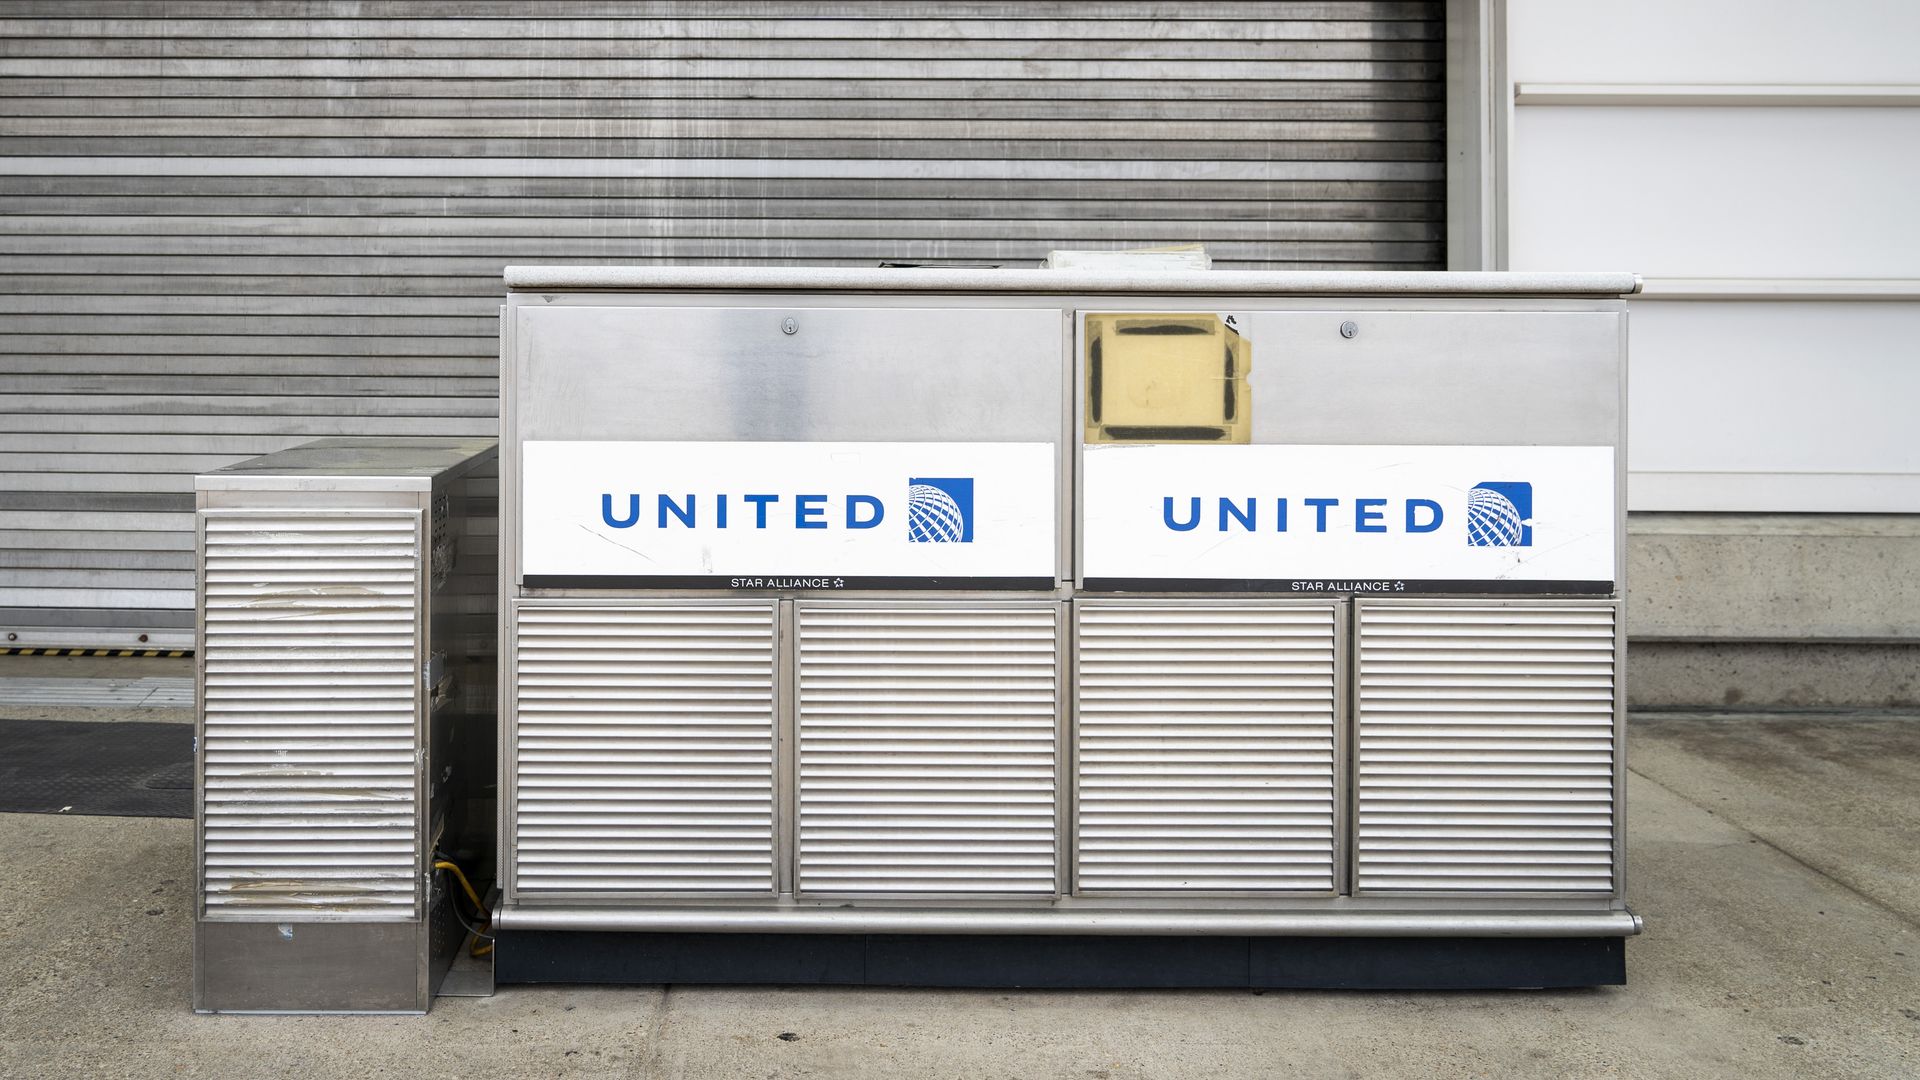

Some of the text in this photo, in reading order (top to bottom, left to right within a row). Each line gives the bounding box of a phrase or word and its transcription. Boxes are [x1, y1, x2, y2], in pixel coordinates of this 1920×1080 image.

[601, 493, 885, 529] UNITED
[1163, 496, 1444, 533] UNITED
[731, 578, 830, 588] STAR ALLIANCE
[1291, 581, 1390, 591] STAR ALLIANCE
